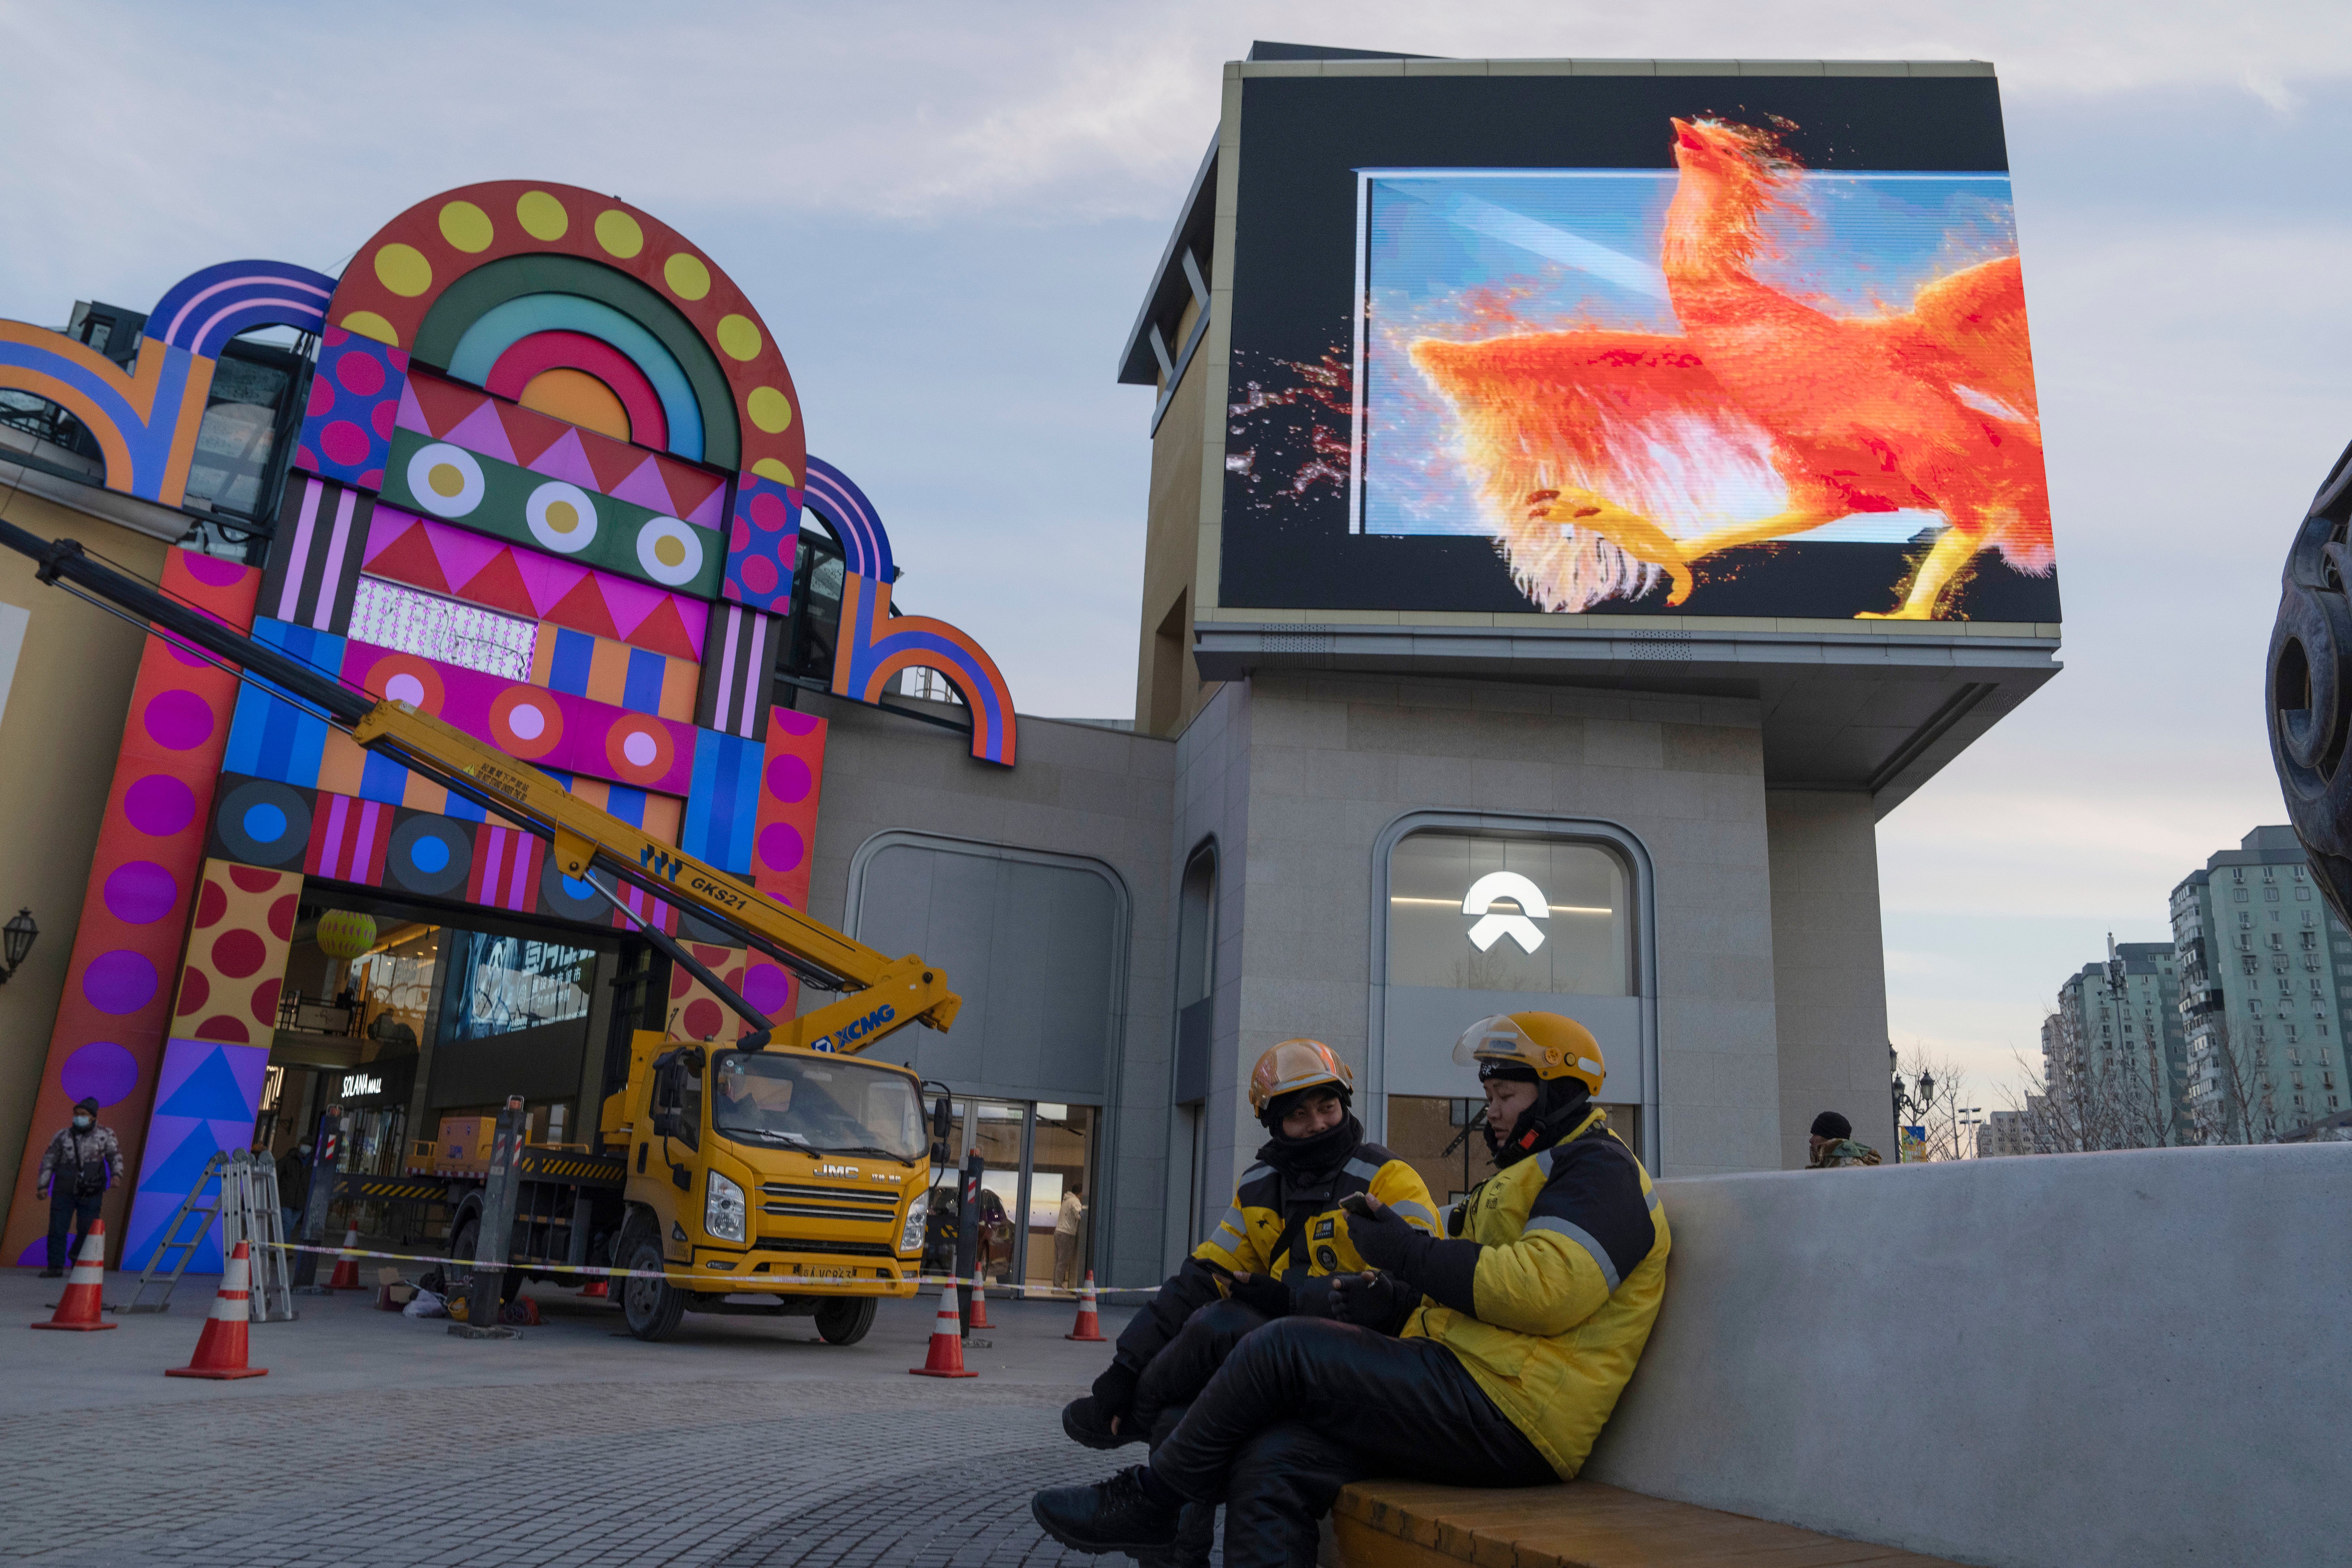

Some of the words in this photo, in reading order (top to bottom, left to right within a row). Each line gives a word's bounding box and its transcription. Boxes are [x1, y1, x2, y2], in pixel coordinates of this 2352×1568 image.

[691, 878, 747, 910] GKS21
[833, 1004, 895, 1051] XCMG
[341, 1073, 368, 1098] SOLANA
[367, 1077, 382, 1094] MALL
[813, 1163, 859, 1179] JMC
